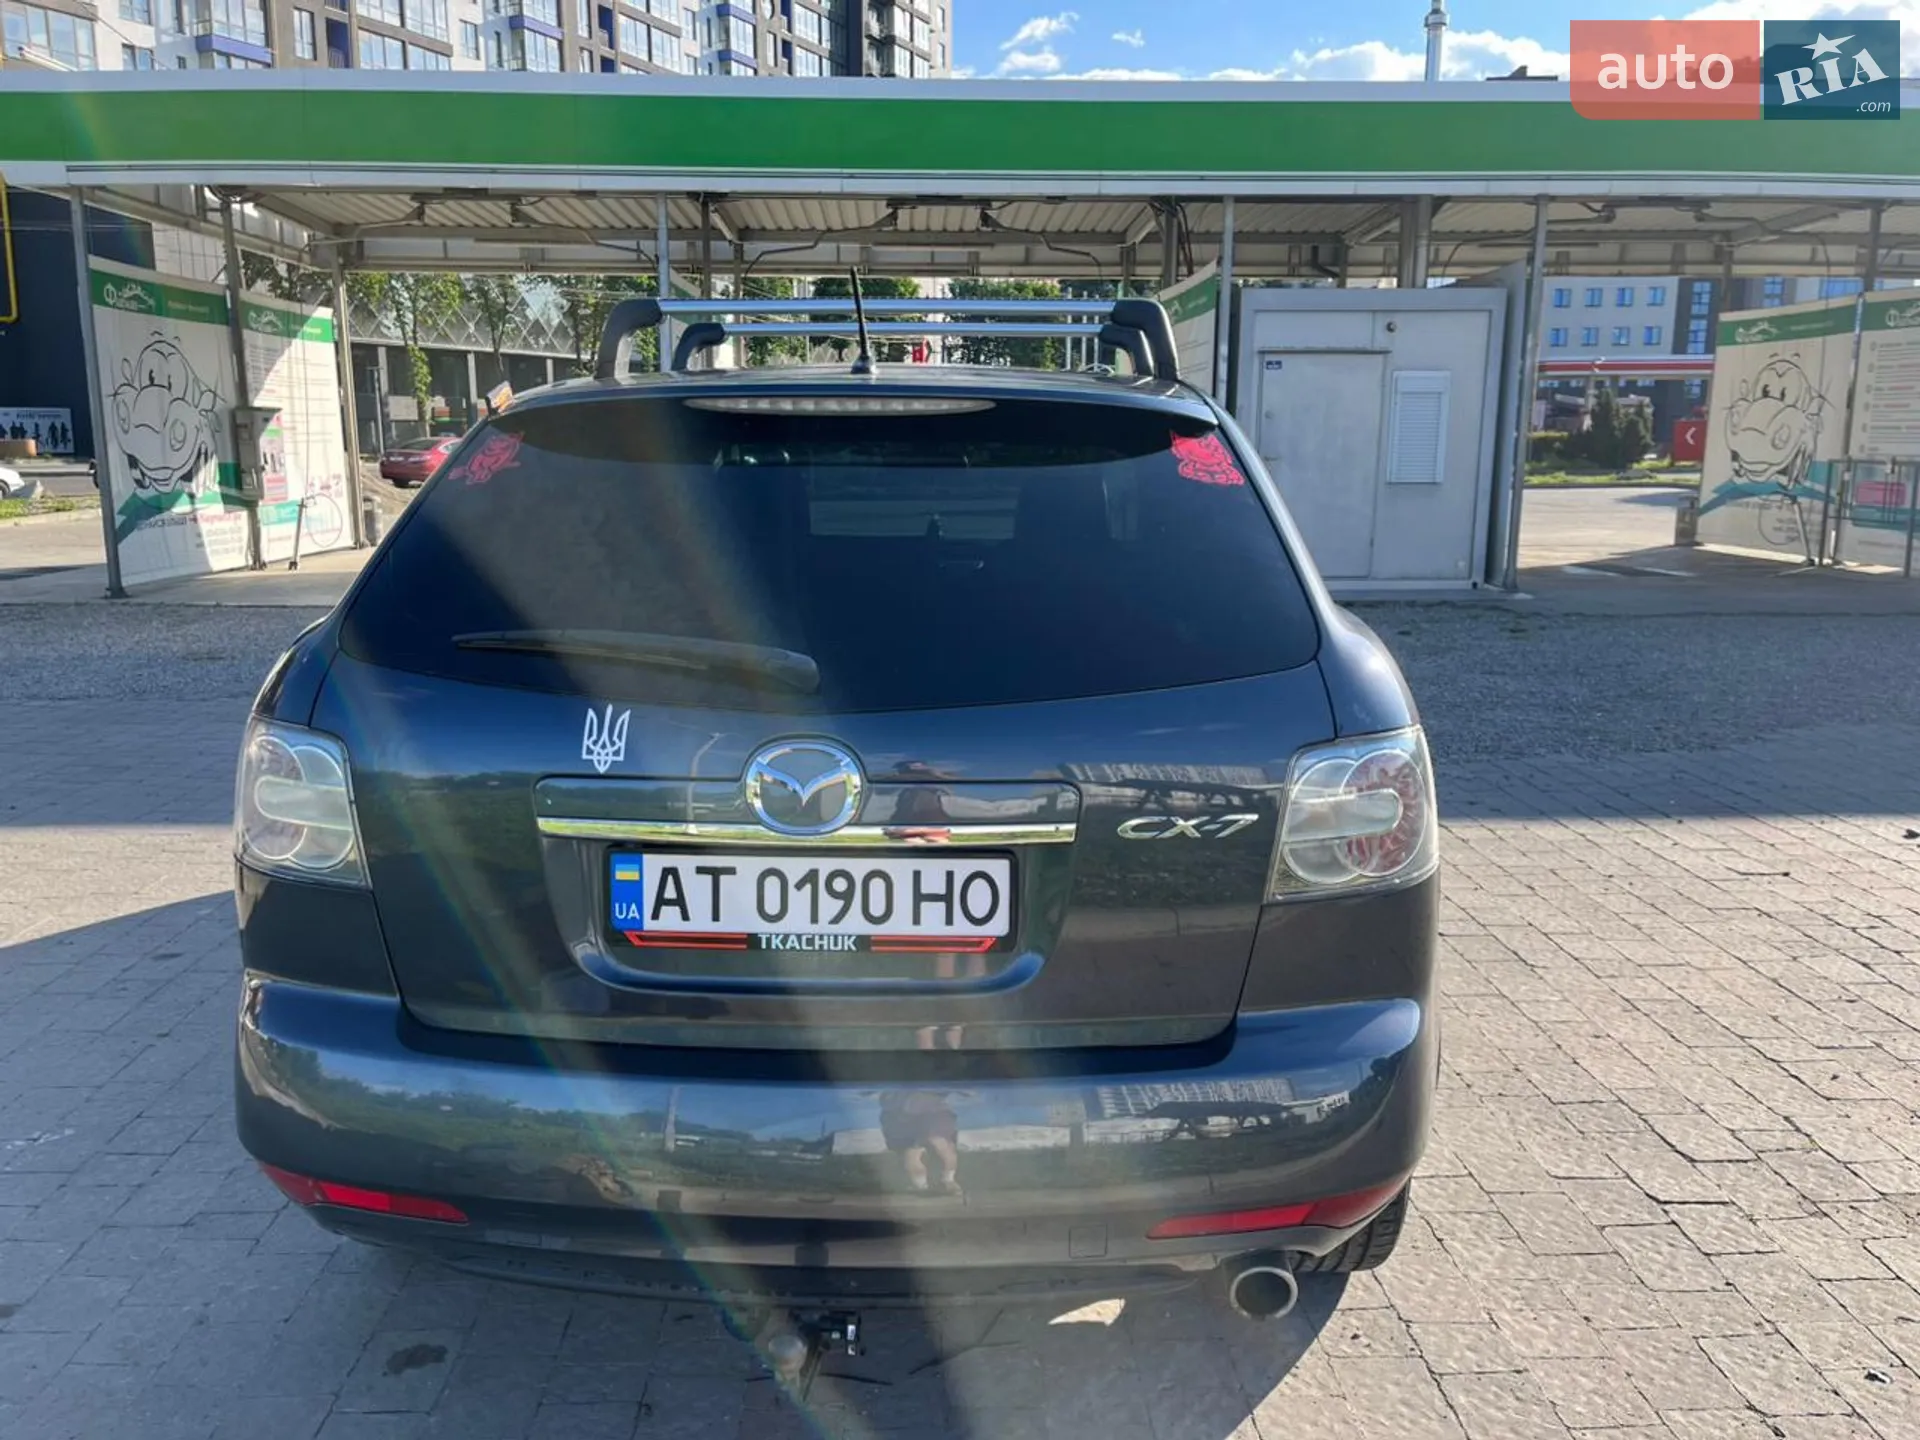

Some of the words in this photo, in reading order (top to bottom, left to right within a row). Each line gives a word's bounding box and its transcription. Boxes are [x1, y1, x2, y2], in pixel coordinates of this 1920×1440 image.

[1117, 813, 1259, 839] CX-7
[650, 866, 737, 922] AT
[755, 867, 894, 926] 0190
[911, 869, 1000, 927] HO
[615, 903, 640, 920] UA
[757, 934, 857, 952] TKACHUK
